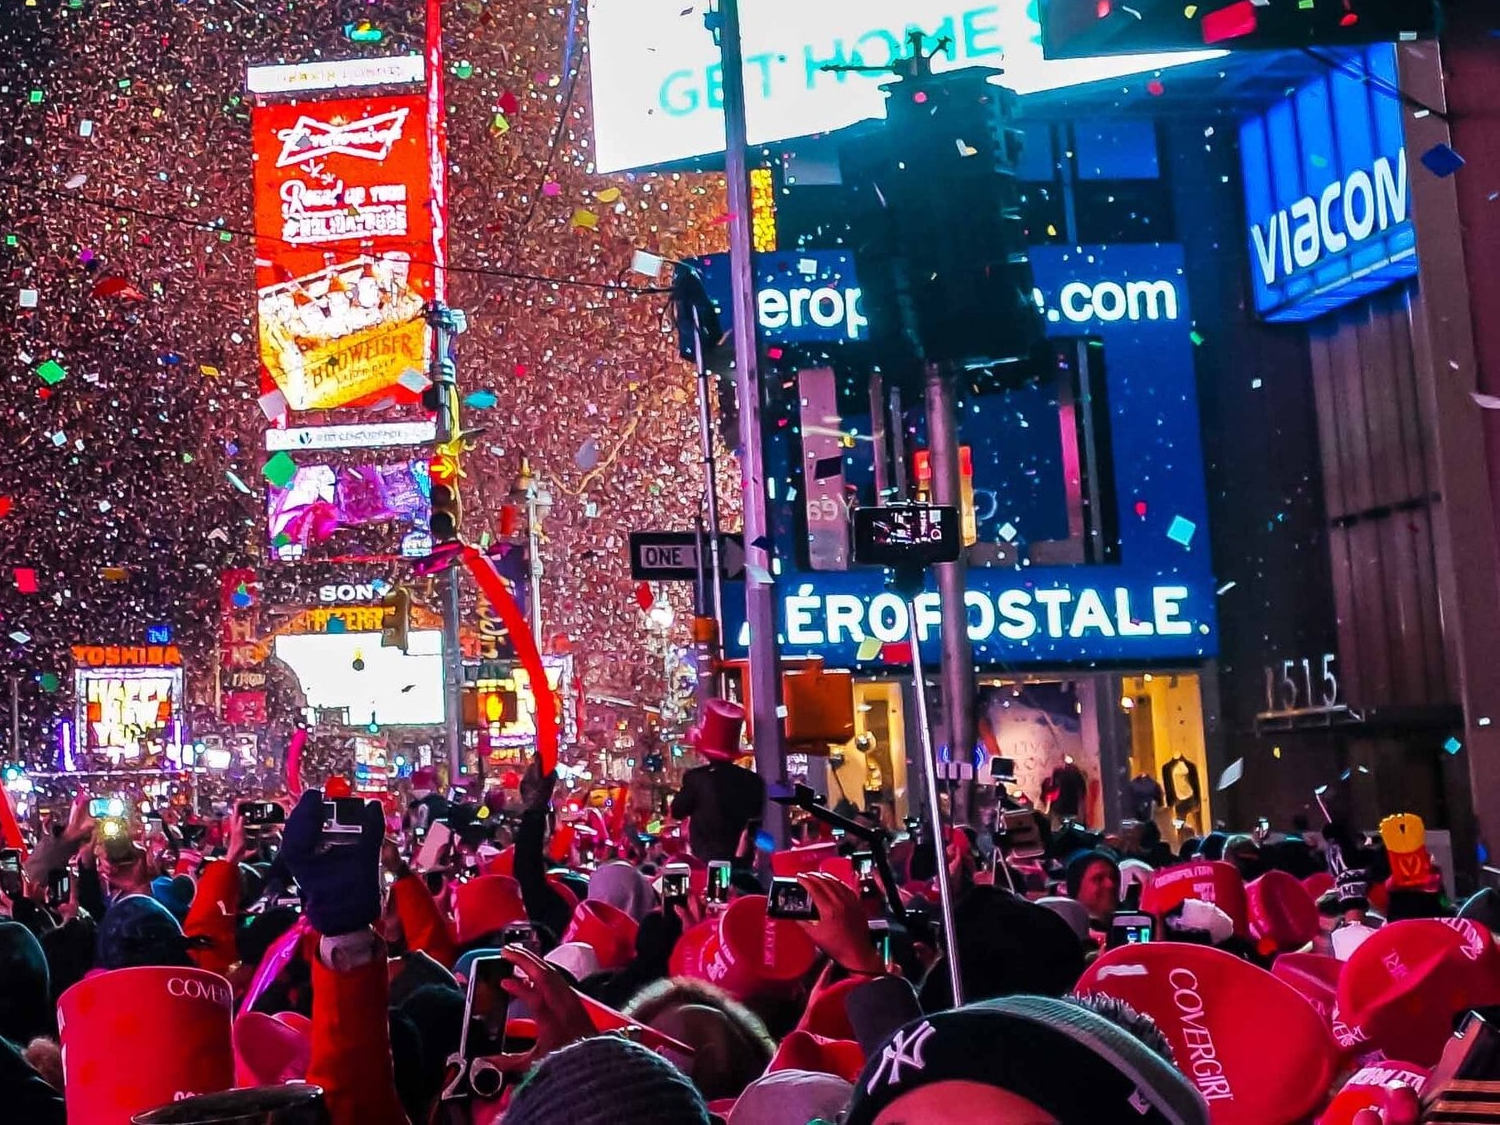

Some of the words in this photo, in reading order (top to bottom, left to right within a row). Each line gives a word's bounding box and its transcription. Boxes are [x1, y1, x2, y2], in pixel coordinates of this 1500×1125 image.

[803, 6, 1005, 91] HOME
[645, 546, 683, 566] ONE
[71, 644, 182, 667] TOSHIBA
[1265, 653, 1337, 714] 1515
[1168, 967, 1235, 1105] COVERGIRL
